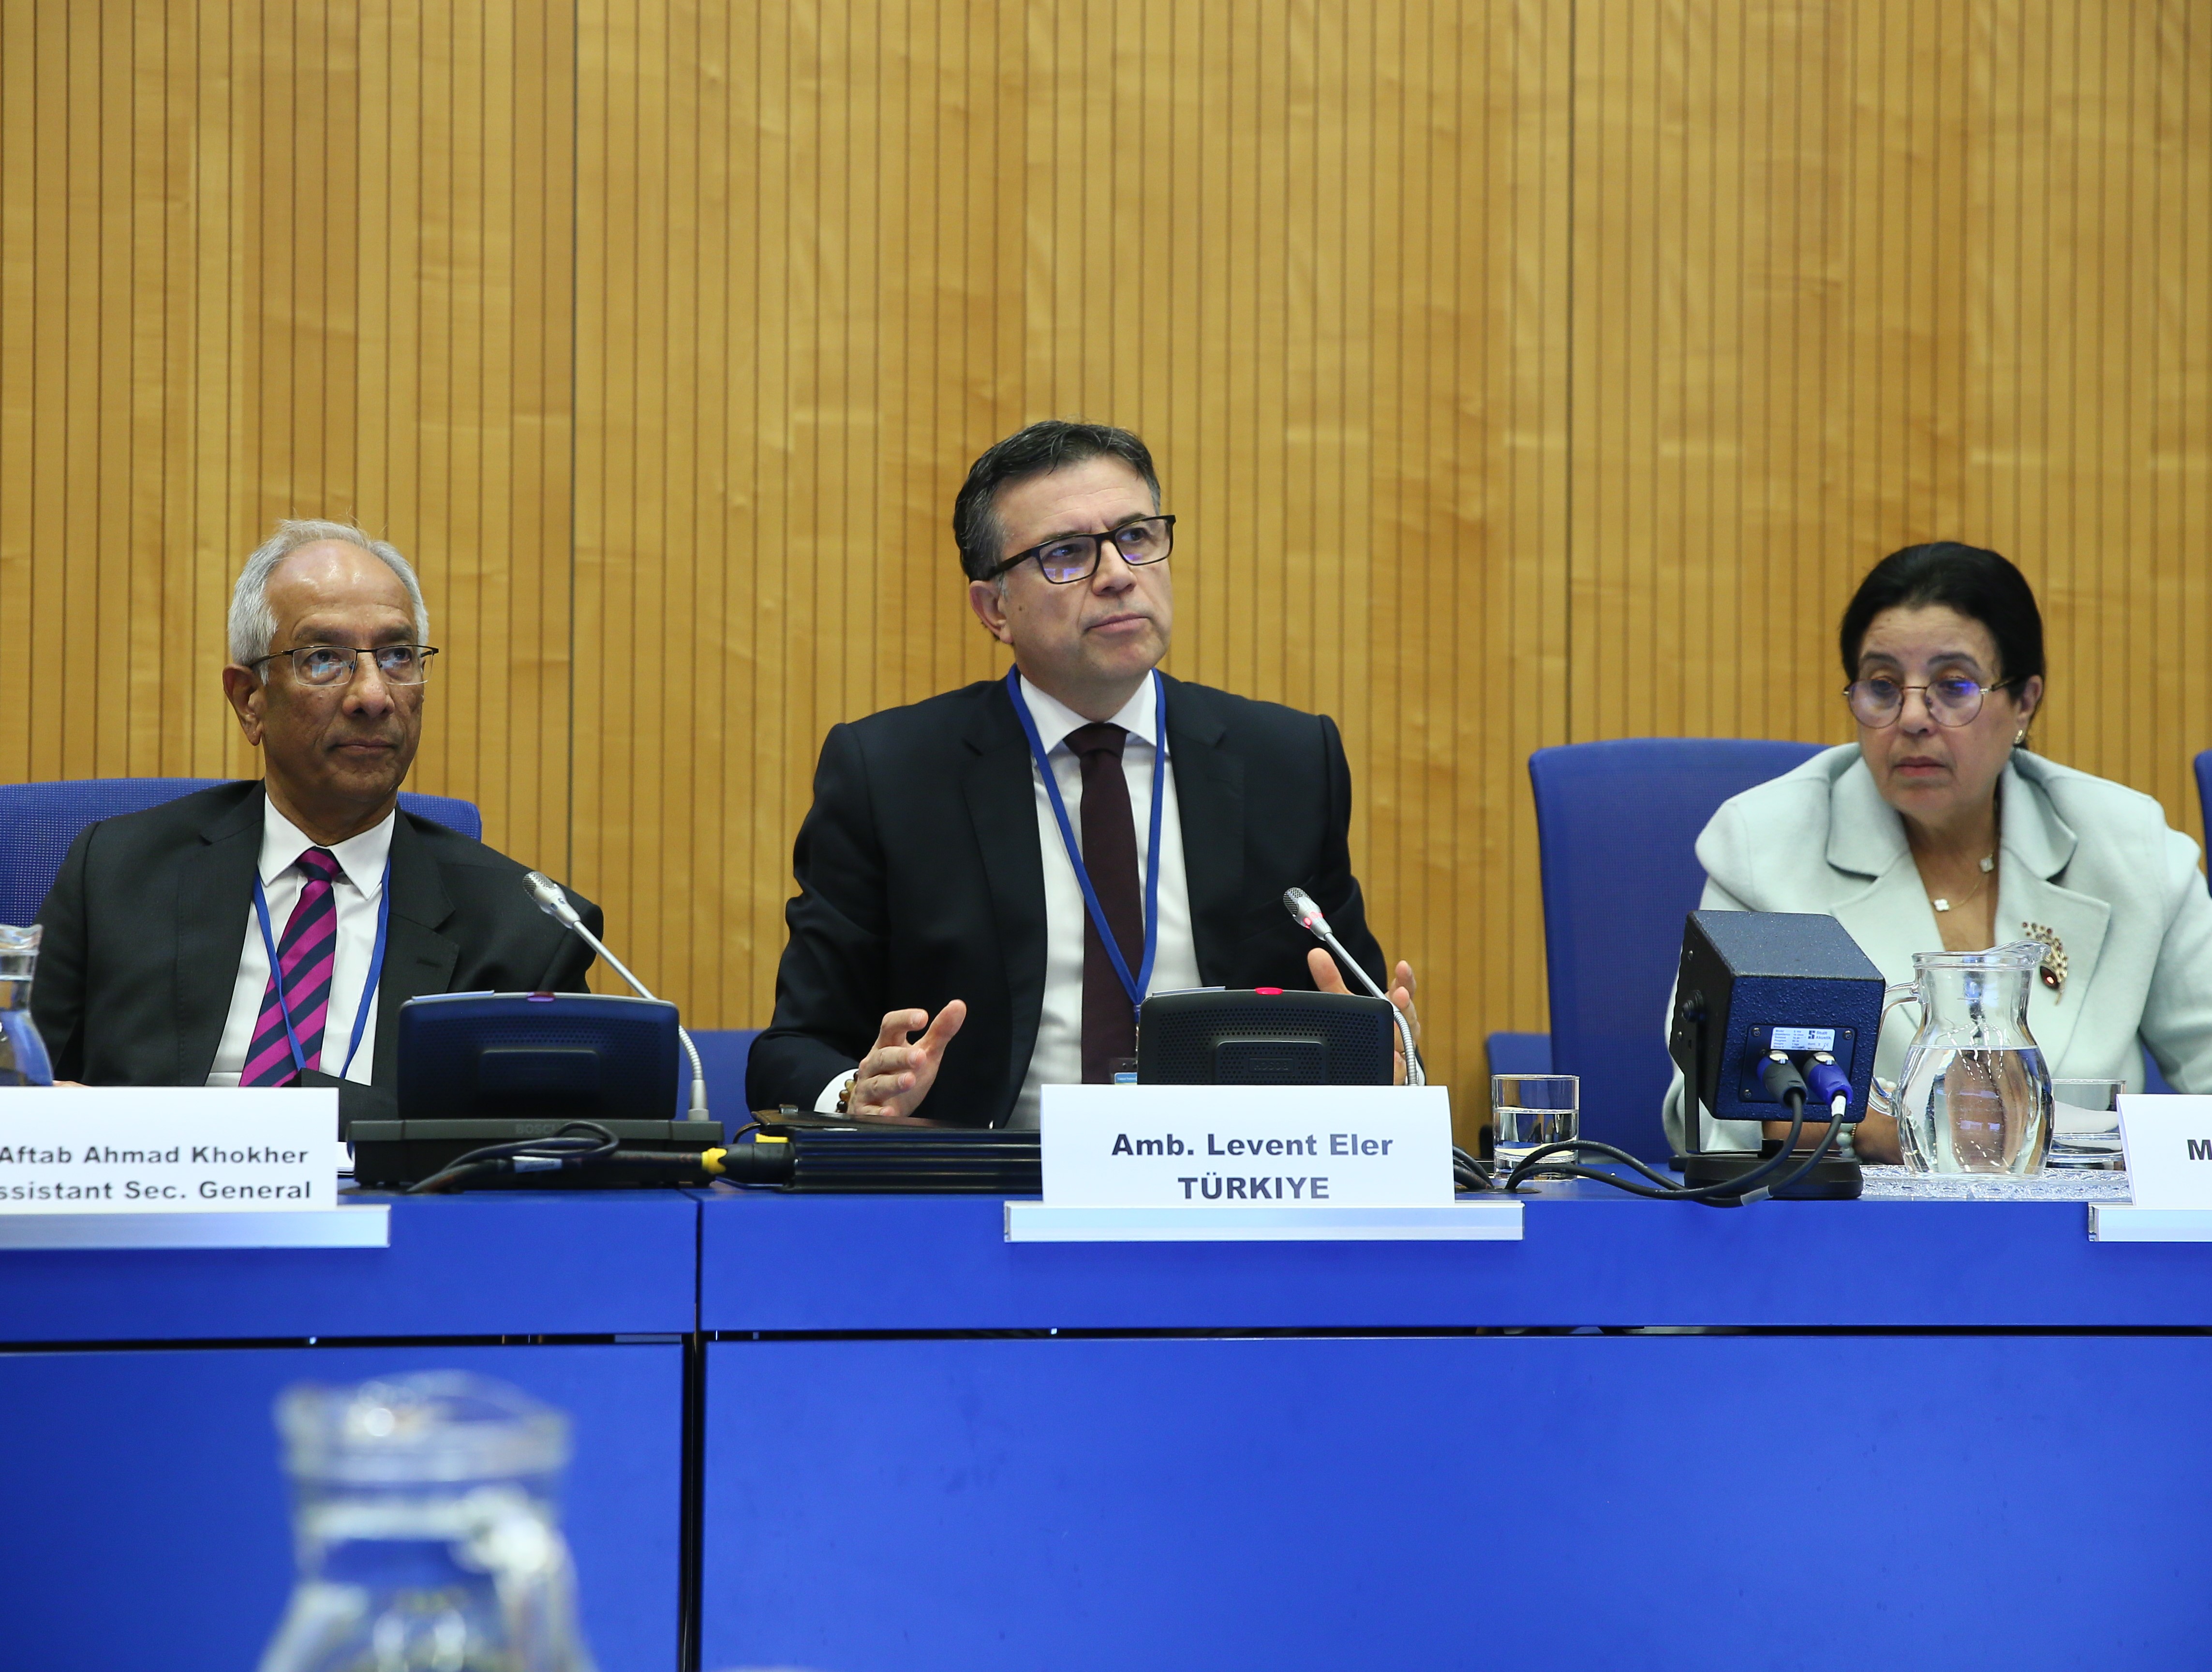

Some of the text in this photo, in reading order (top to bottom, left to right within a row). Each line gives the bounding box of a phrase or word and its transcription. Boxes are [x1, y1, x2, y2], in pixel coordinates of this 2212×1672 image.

[1112, 1134, 1393, 1155] Amb. Levent Eler
[0, 1146, 308, 1163] Aftab Ahmad Khokher
[126, 1181, 185, 1199] Sec.
[199, 1181, 310, 1198] General
[1178, 1172, 1329, 1199] TÜRKIYE
